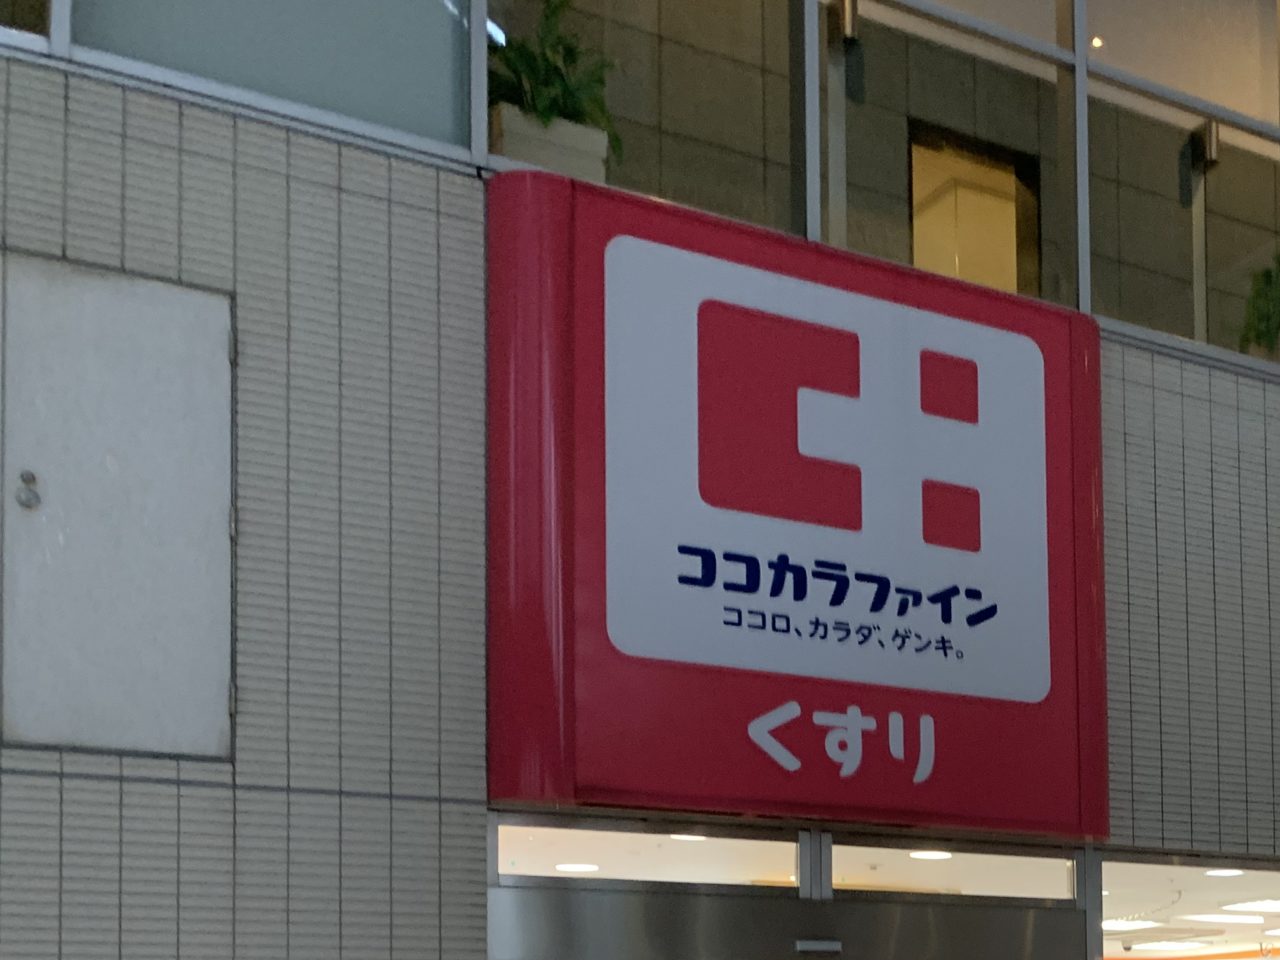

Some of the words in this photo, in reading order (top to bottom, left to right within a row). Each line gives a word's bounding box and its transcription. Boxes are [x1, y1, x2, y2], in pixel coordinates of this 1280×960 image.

[677, 544, 998, 627] ココカラファイン
[722, 606, 965, 661] ココロ、カラダ、ゲンキ。
[747, 700, 936, 784] くすり
